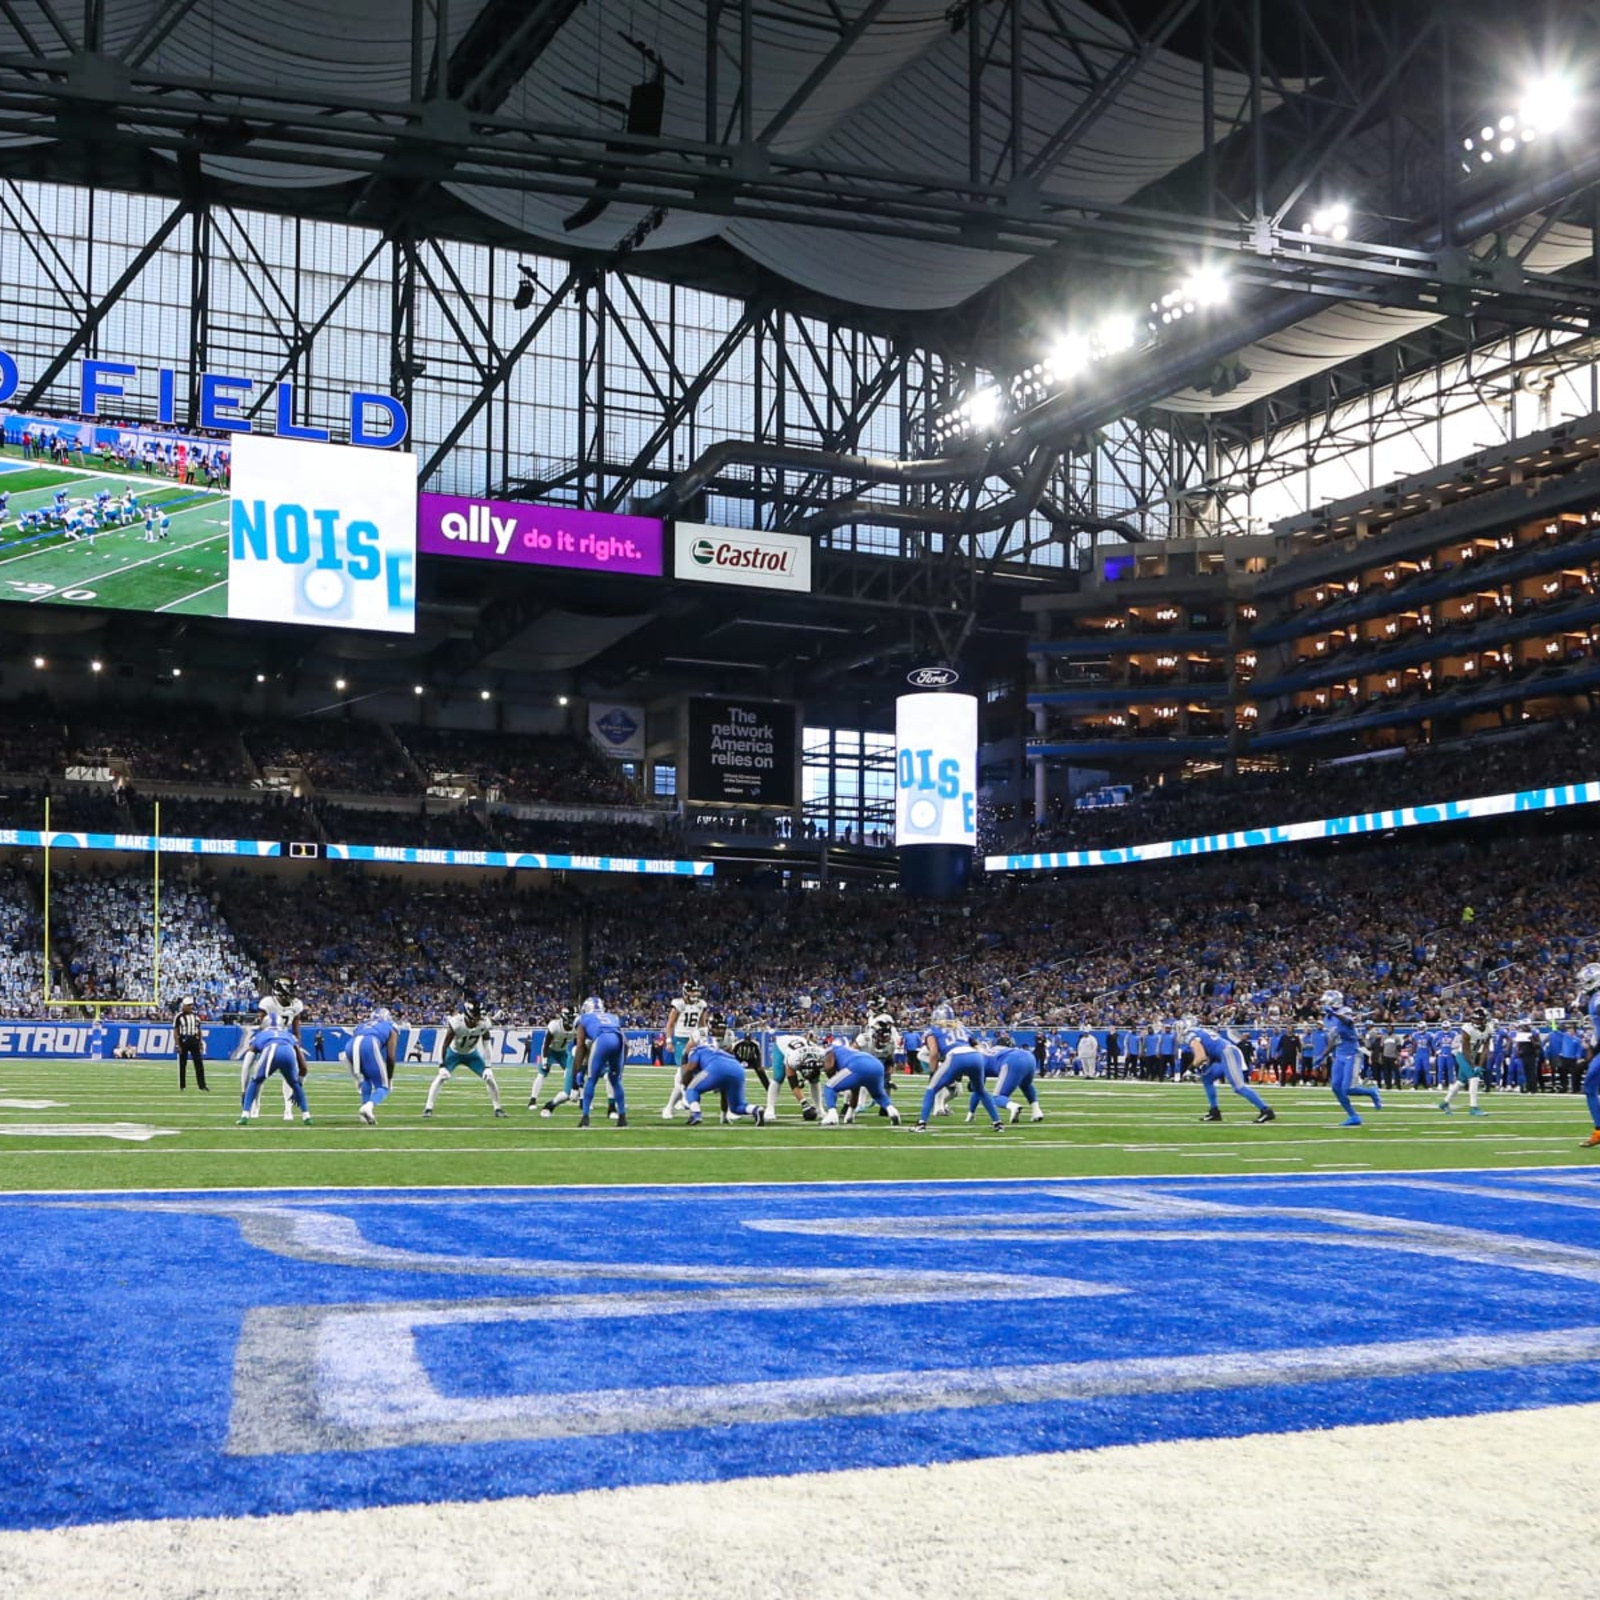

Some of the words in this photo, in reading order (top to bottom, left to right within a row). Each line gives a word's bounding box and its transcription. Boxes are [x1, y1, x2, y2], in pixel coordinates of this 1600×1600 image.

[80, 358, 408, 448] FIELD
[440, 504, 517, 555] ally
[523, 528, 550, 550] do
[557, 530, 575, 552] it
[579, 536, 642, 561] right.
[715, 543, 788, 572] Castrol
[916, 670, 949, 684] Ford
[728, 707, 757, 724] The
[711, 722, 773, 739] network
[711, 736, 773, 754] America
[711, 752, 753, 767] relies
[754, 756, 773, 768] on
[115, 834, 150, 850] MAKE
[159, 838, 194, 852] SOME
[201, 839, 237, 853] NOISE
[374, 847, 406, 860] MAKE
[416, 850, 447, 863] SOME
[454, 851, 486, 864] NOISE
[570, 856, 601, 869] MAKE
[609, 858, 638, 872] SOME
[645, 859, 676, 873] NOISE
[683, 1012, 698, 1028] 16
[117, 1028, 210, 1055] LIO
[460, 1035, 479, 1048] 17
